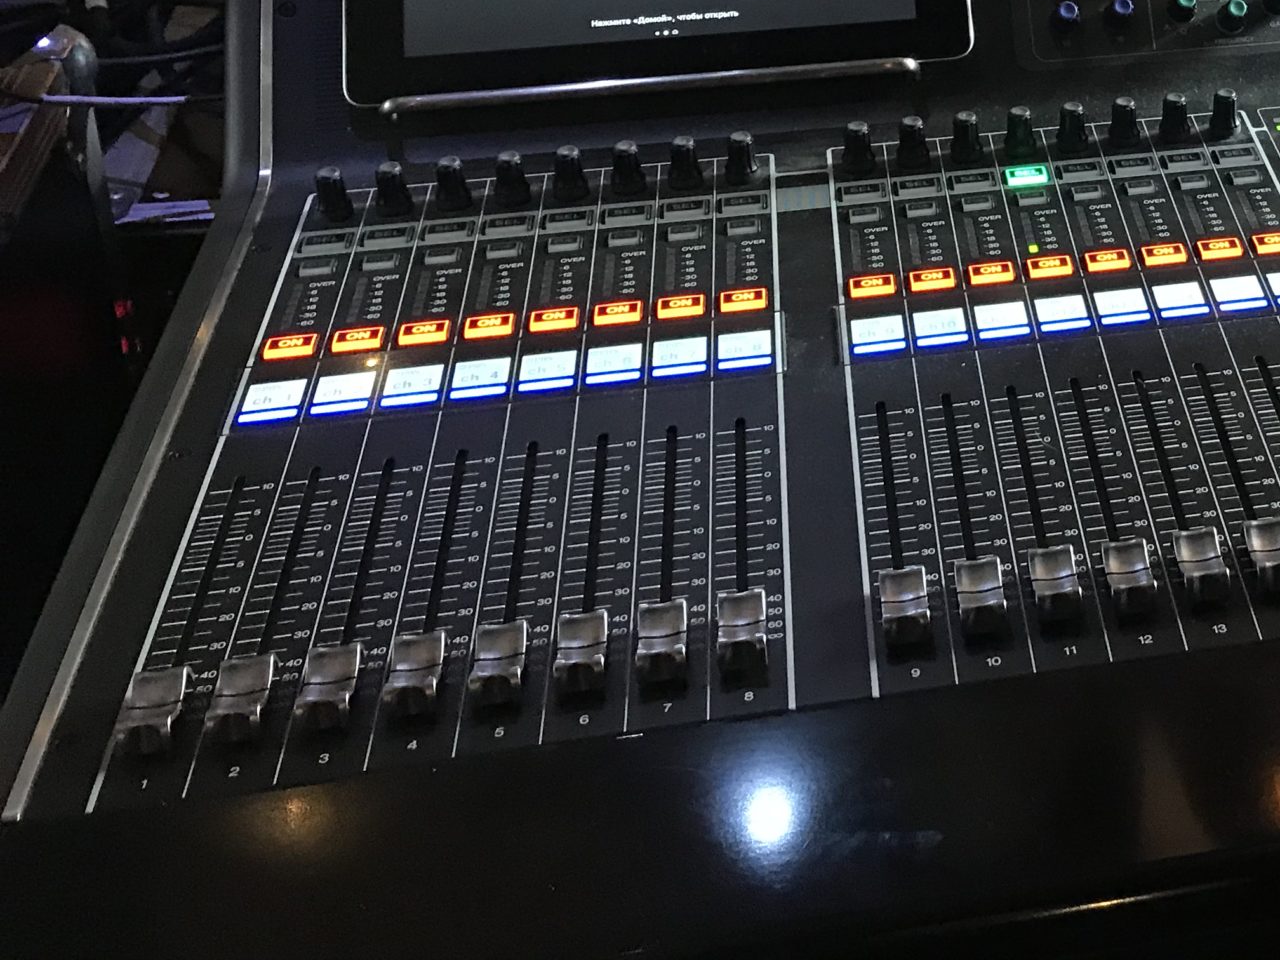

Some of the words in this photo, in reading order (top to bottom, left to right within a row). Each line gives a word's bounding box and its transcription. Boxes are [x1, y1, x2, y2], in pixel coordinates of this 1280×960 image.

[676, 12, 703, 21] чтобы
[704, 10, 740, 21] открыть
[1209, 240, 1230, 249] ON
[1153, 246, 1174, 255] ON
[1096, 252, 1118, 261] ON
[1038, 259, 1061, 268] ON
[980, 265, 1002, 274] ON
[921, 271, 943, 281] ON
[309, 280, 336, 288] OVER
[861, 278, 883, 287] ON
[731, 292, 755, 301] ON
[669, 298, 693, 307] ON
[606, 304, 630, 314] ON
[542, 311, 566, 320] ON
[477, 317, 502, 327] ON
[412, 324, 437, 333] ON
[346, 330, 371, 340] ON
[278, 337, 303, 347] ON
[252, 395, 272, 405] ch
[766, 518, 777, 526] 10
[766, 542, 780, 550] 20
[767, 568, 781, 576] 30
[768, 594, 782, 602] 40
[218, 613, 234, 621] 20
[1212, 624, 1228, 634] 13
[1138, 634, 1154, 645] 12
[209, 641, 226, 650] 30
[1063, 645, 1078, 656] 11
[986, 656, 1002, 667] 10
[198, 670, 216, 679] 40
[910, 668, 921, 678] 9
[744, 691, 754, 701] 8
[663, 703, 673, 713] 7
[579, 714, 589, 725] 6
[494, 727, 504, 738] 5
[406, 740, 418, 751] 4
[318, 753, 330, 764] 3
[229, 766, 240, 777] 2
[140, 779, 148, 789] 1
